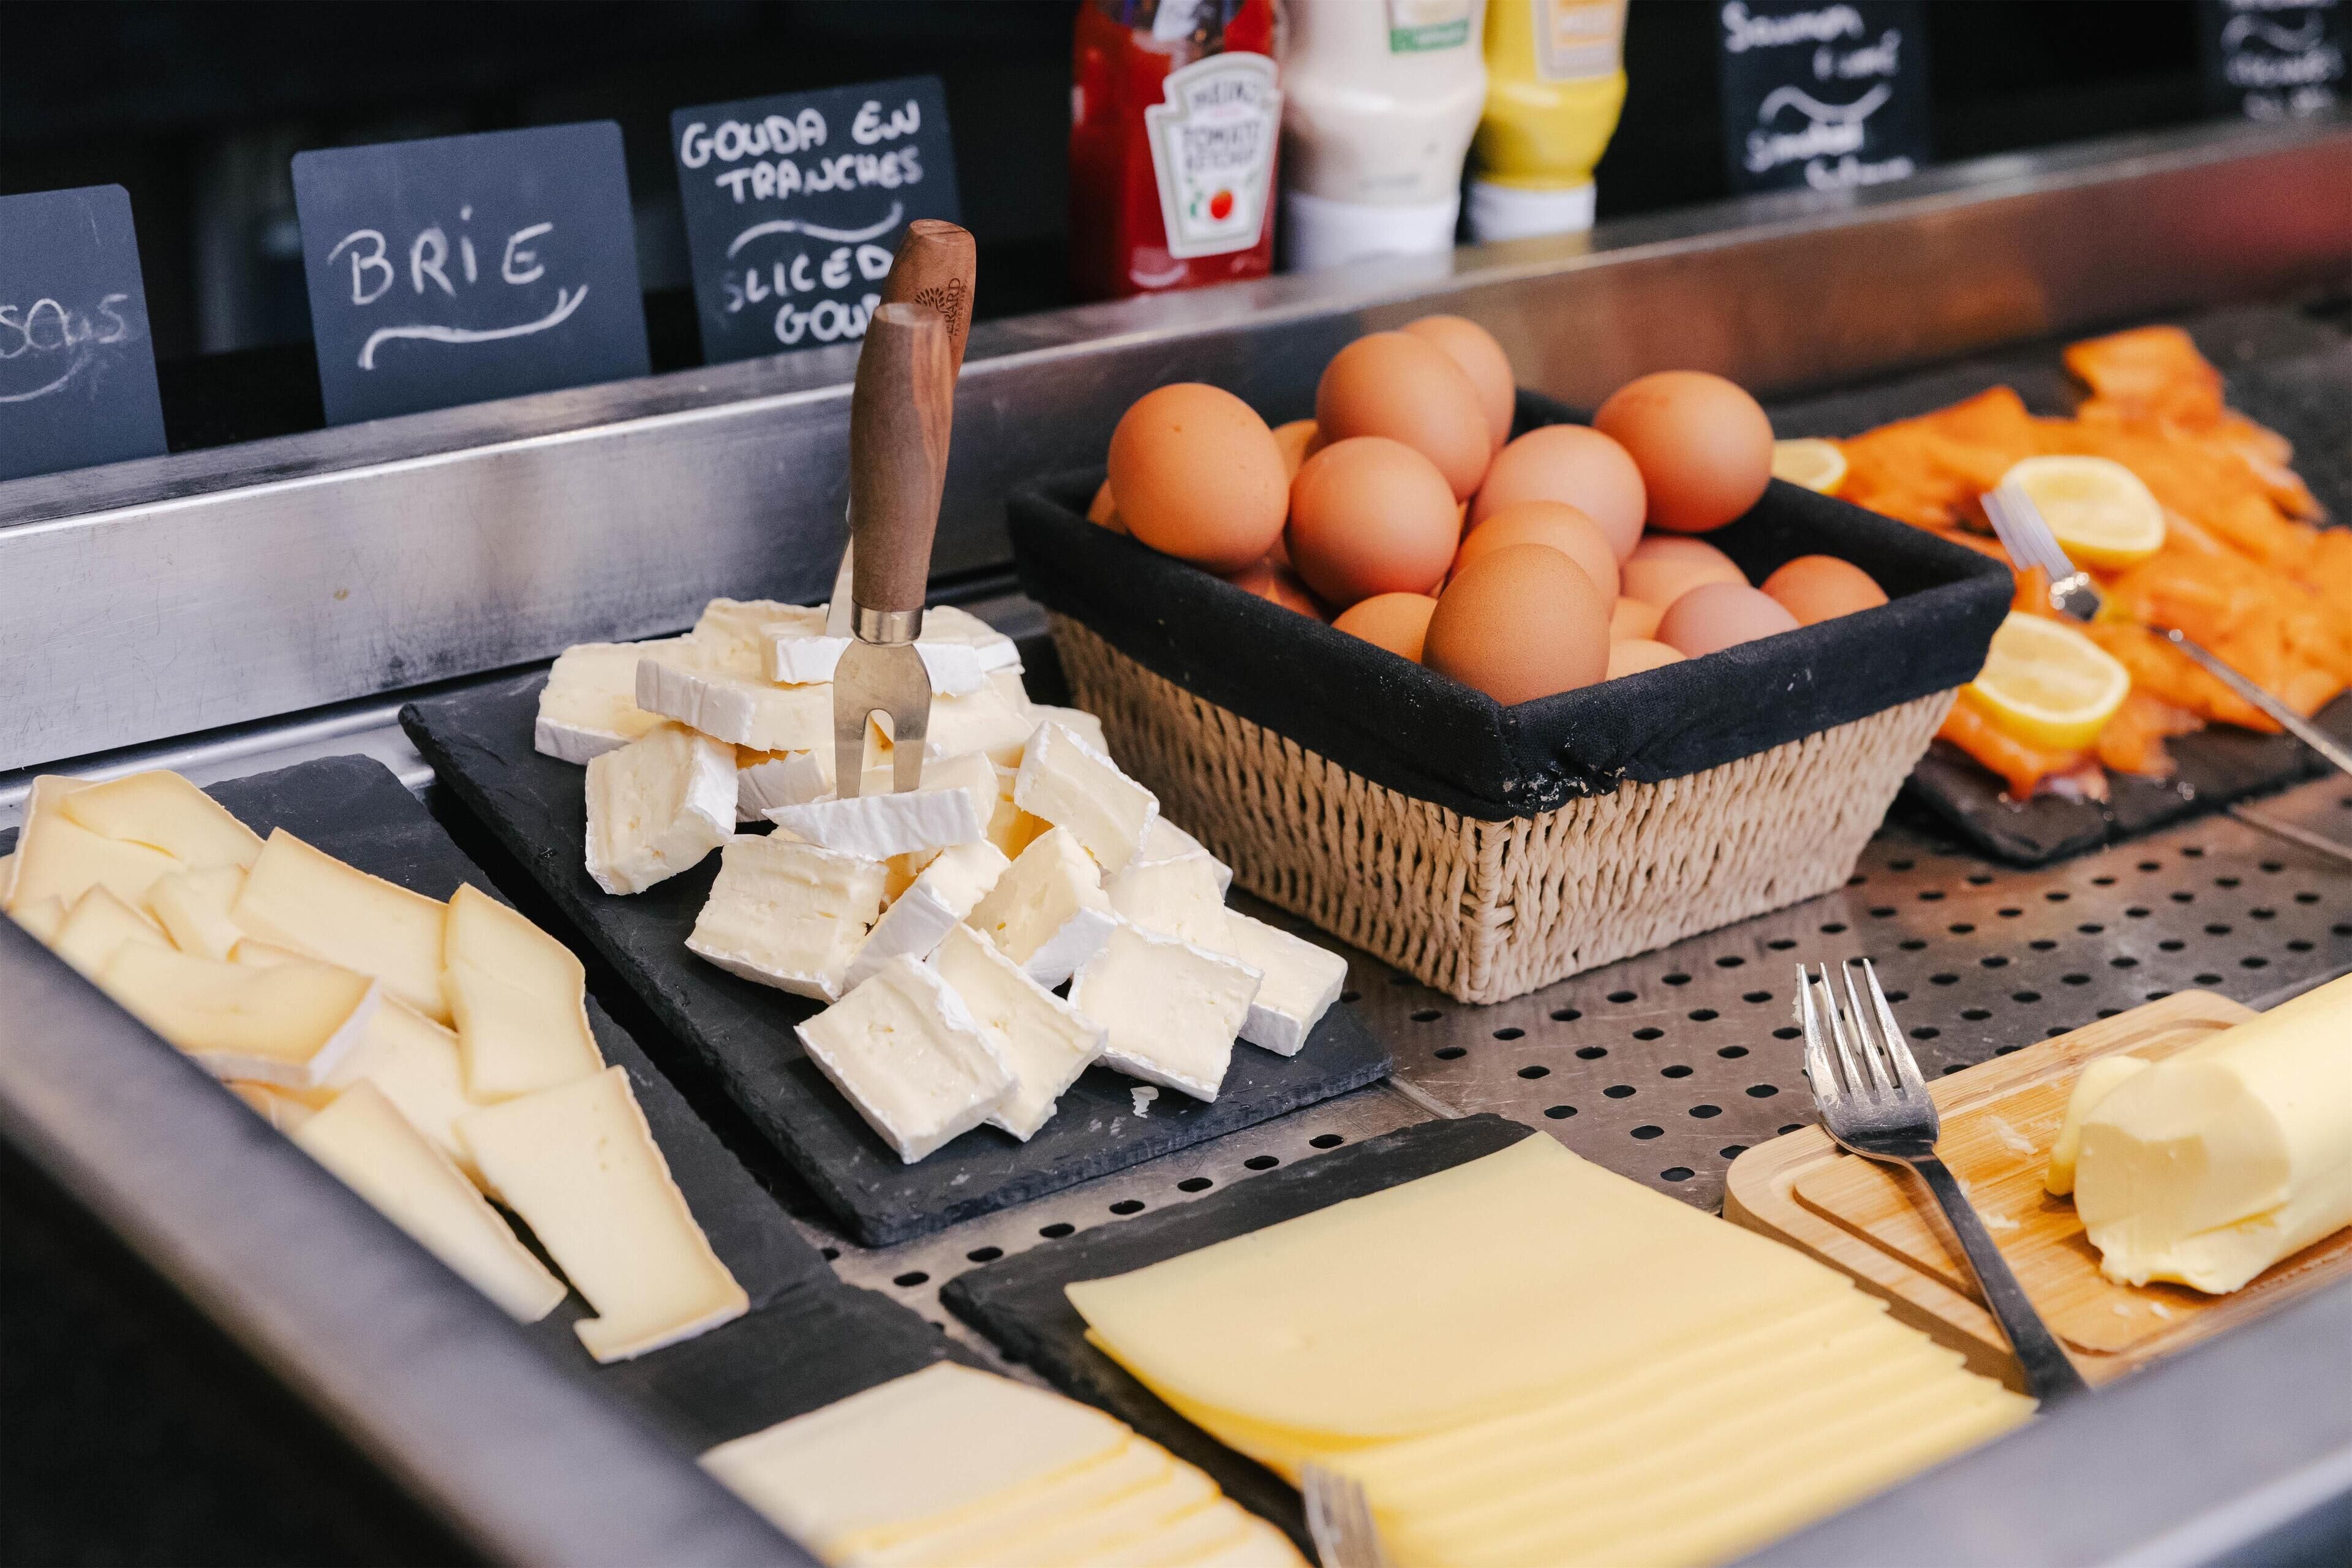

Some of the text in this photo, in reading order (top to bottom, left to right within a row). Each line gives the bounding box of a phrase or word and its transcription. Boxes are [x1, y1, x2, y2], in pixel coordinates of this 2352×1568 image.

[680, 99, 921, 168] GOUDA EN
[715, 145, 924, 203] TRANCHES
[722, 244, 894, 314] SLICED
